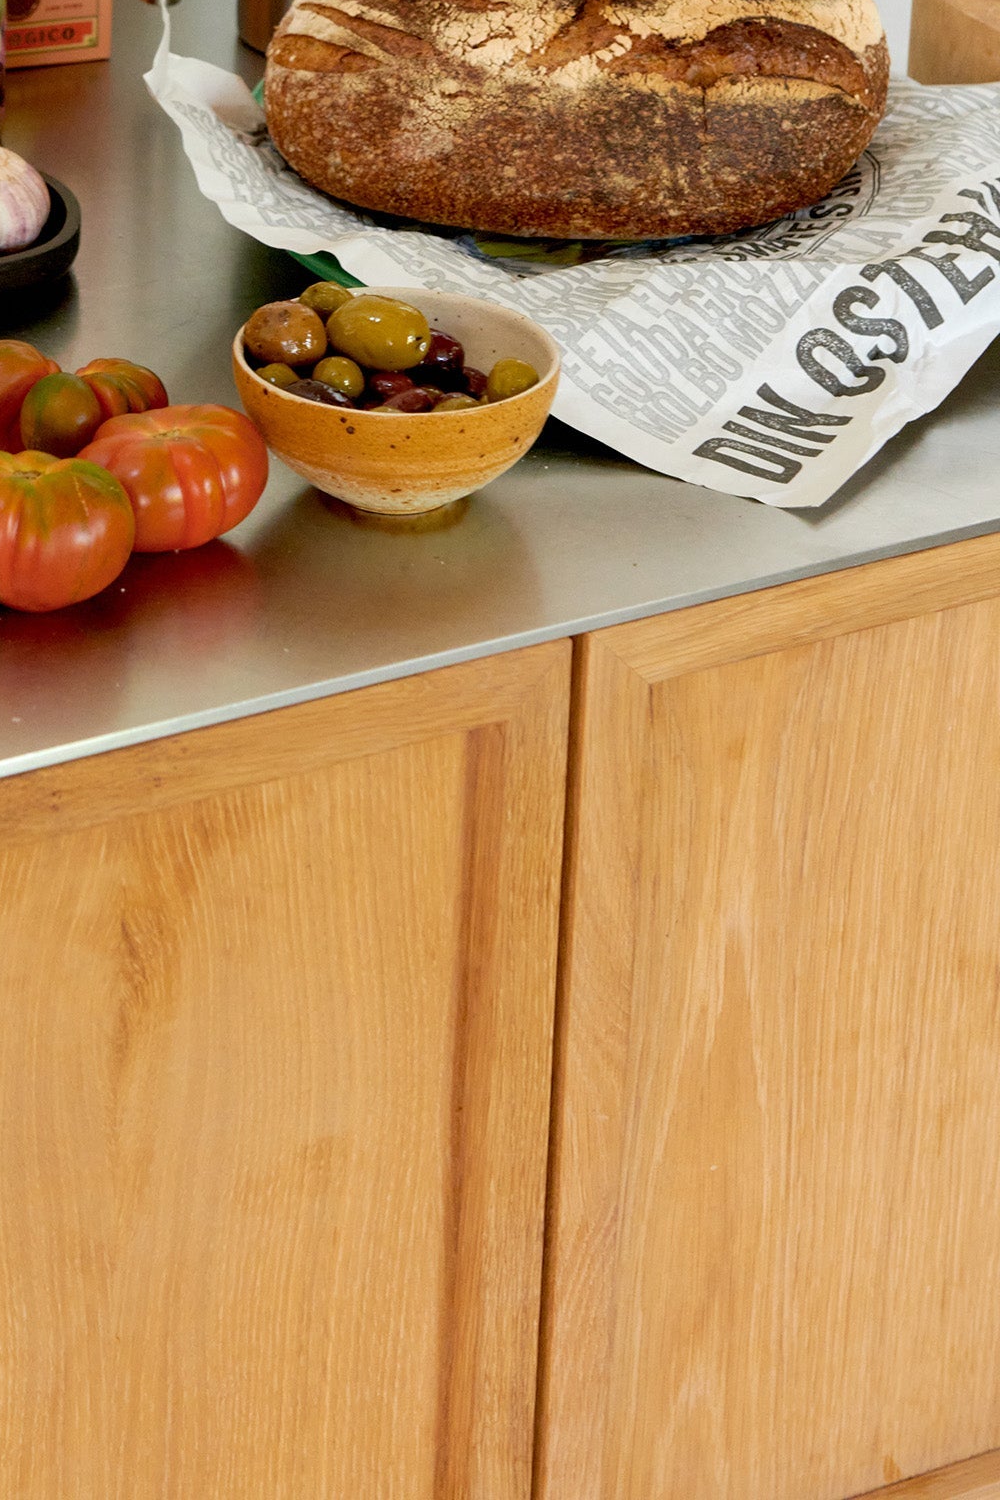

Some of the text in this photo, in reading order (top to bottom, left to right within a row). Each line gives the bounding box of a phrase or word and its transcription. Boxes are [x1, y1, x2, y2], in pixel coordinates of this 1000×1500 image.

[8, 26, 76, 47] OGICO
[588, 309, 712, 423] GOUDA
[629, 340, 743, 444] MOLBO
[692, 381, 853, 484] DIN
